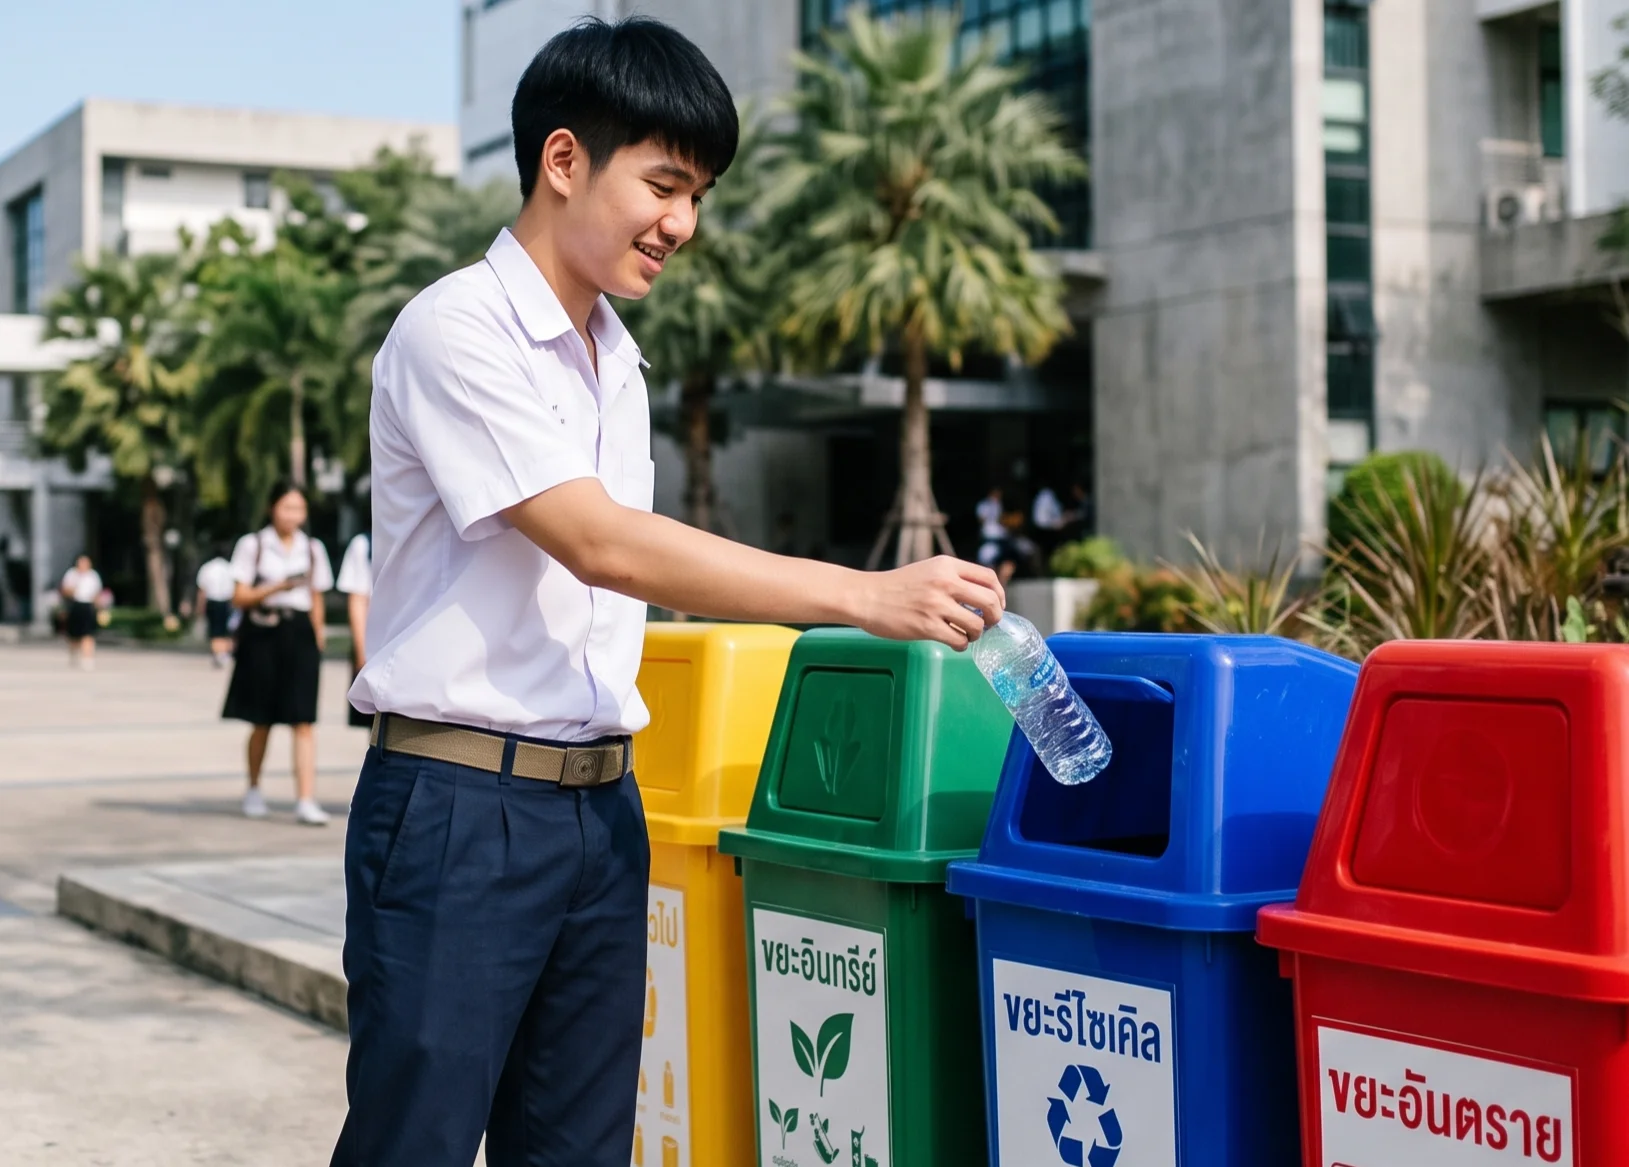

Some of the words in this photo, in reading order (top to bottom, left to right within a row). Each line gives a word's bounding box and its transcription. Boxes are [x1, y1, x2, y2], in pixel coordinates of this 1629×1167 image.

[648, 901, 678, 948] วไป
[761, 937, 877, 996] ขยะอินทรีย์
[1003, 989, 1161, 1063] ขยะรีไซเคิล
[1328, 1068, 1562, 1163] ขยะอันตราย
